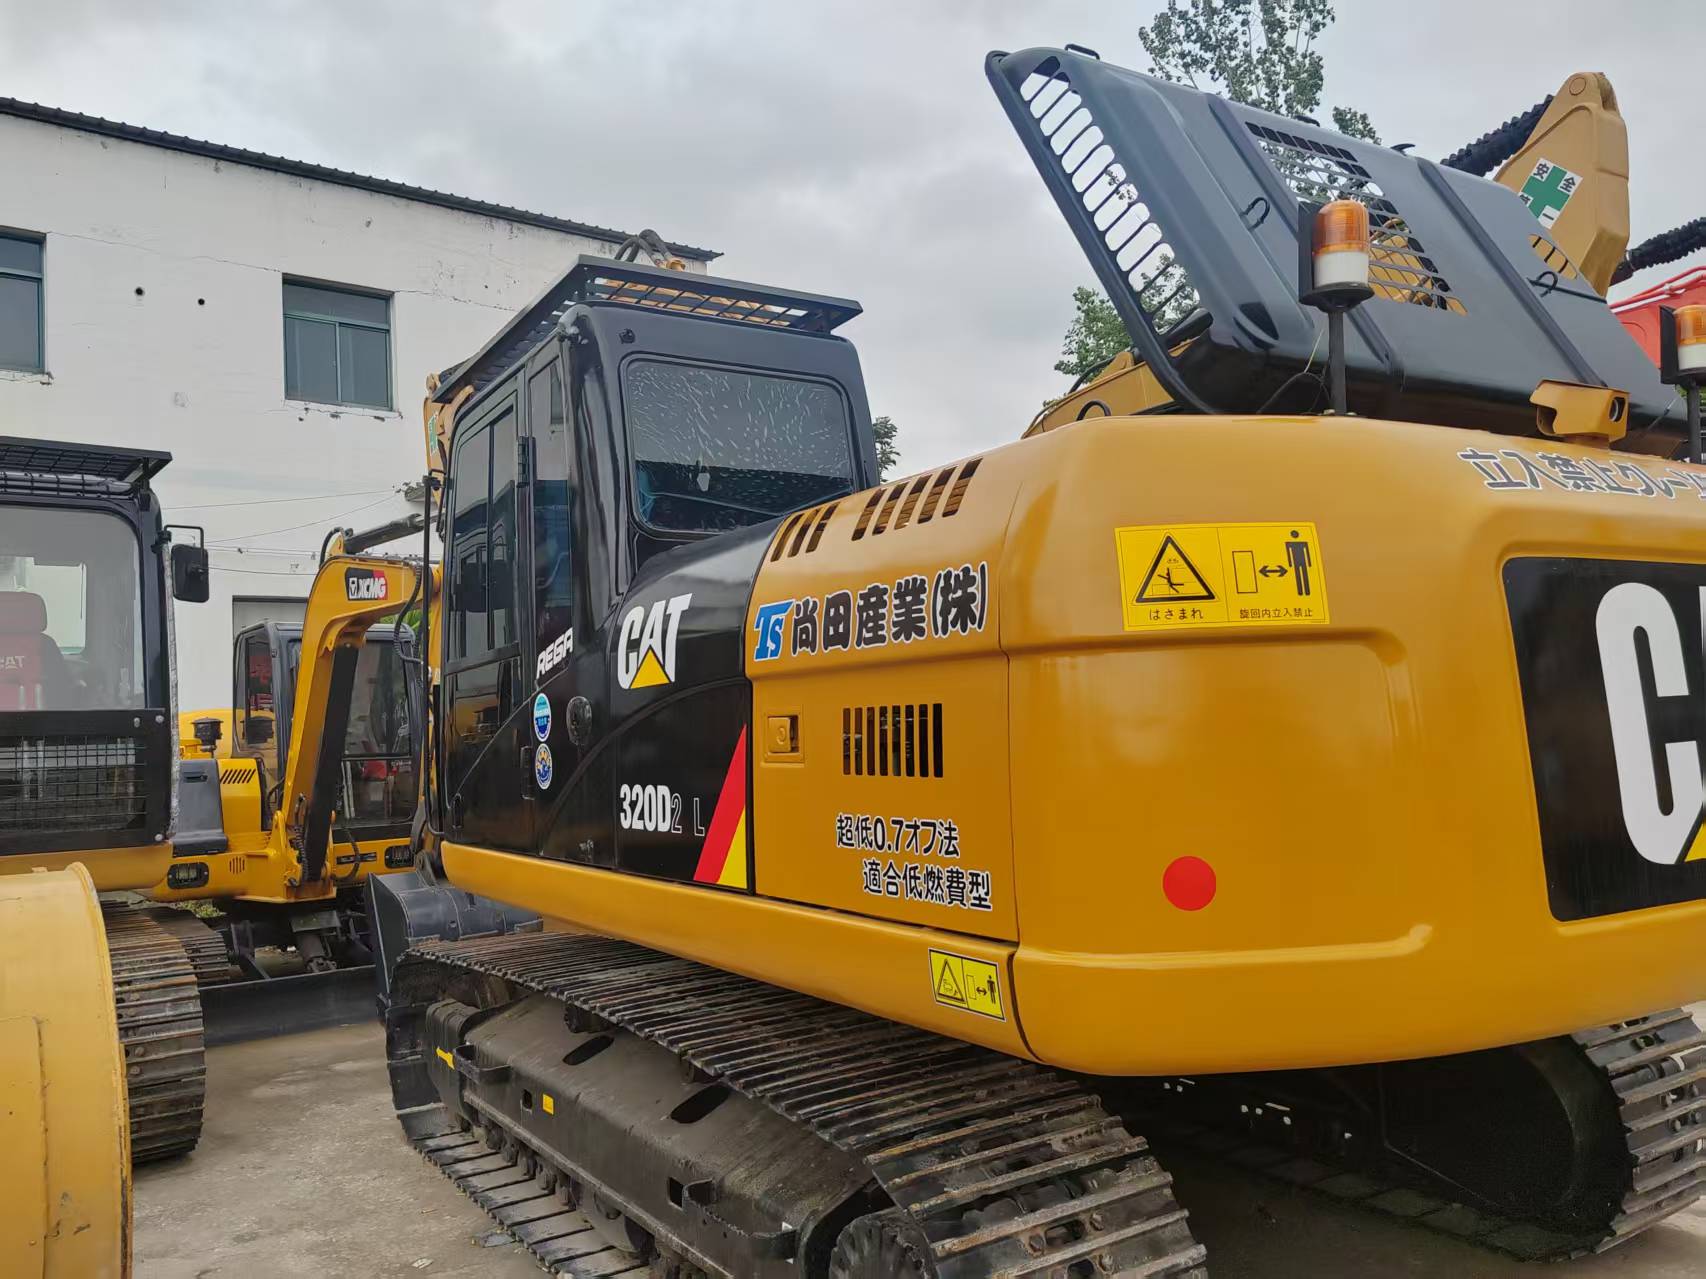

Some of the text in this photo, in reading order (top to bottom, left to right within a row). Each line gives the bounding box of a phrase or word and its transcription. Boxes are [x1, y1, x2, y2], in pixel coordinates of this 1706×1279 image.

[1533, 163, 1576, 193] 安全
[358, 577, 386, 599] XCMG
[790, 561, 988, 657] 尚田産業(株)
[1150, 608, 1203, 620] はさまれ
[536, 627, 573, 679] REGA
[617, 593, 693, 690] CAT
[862, 858, 993, 911] 適合低燃費型
